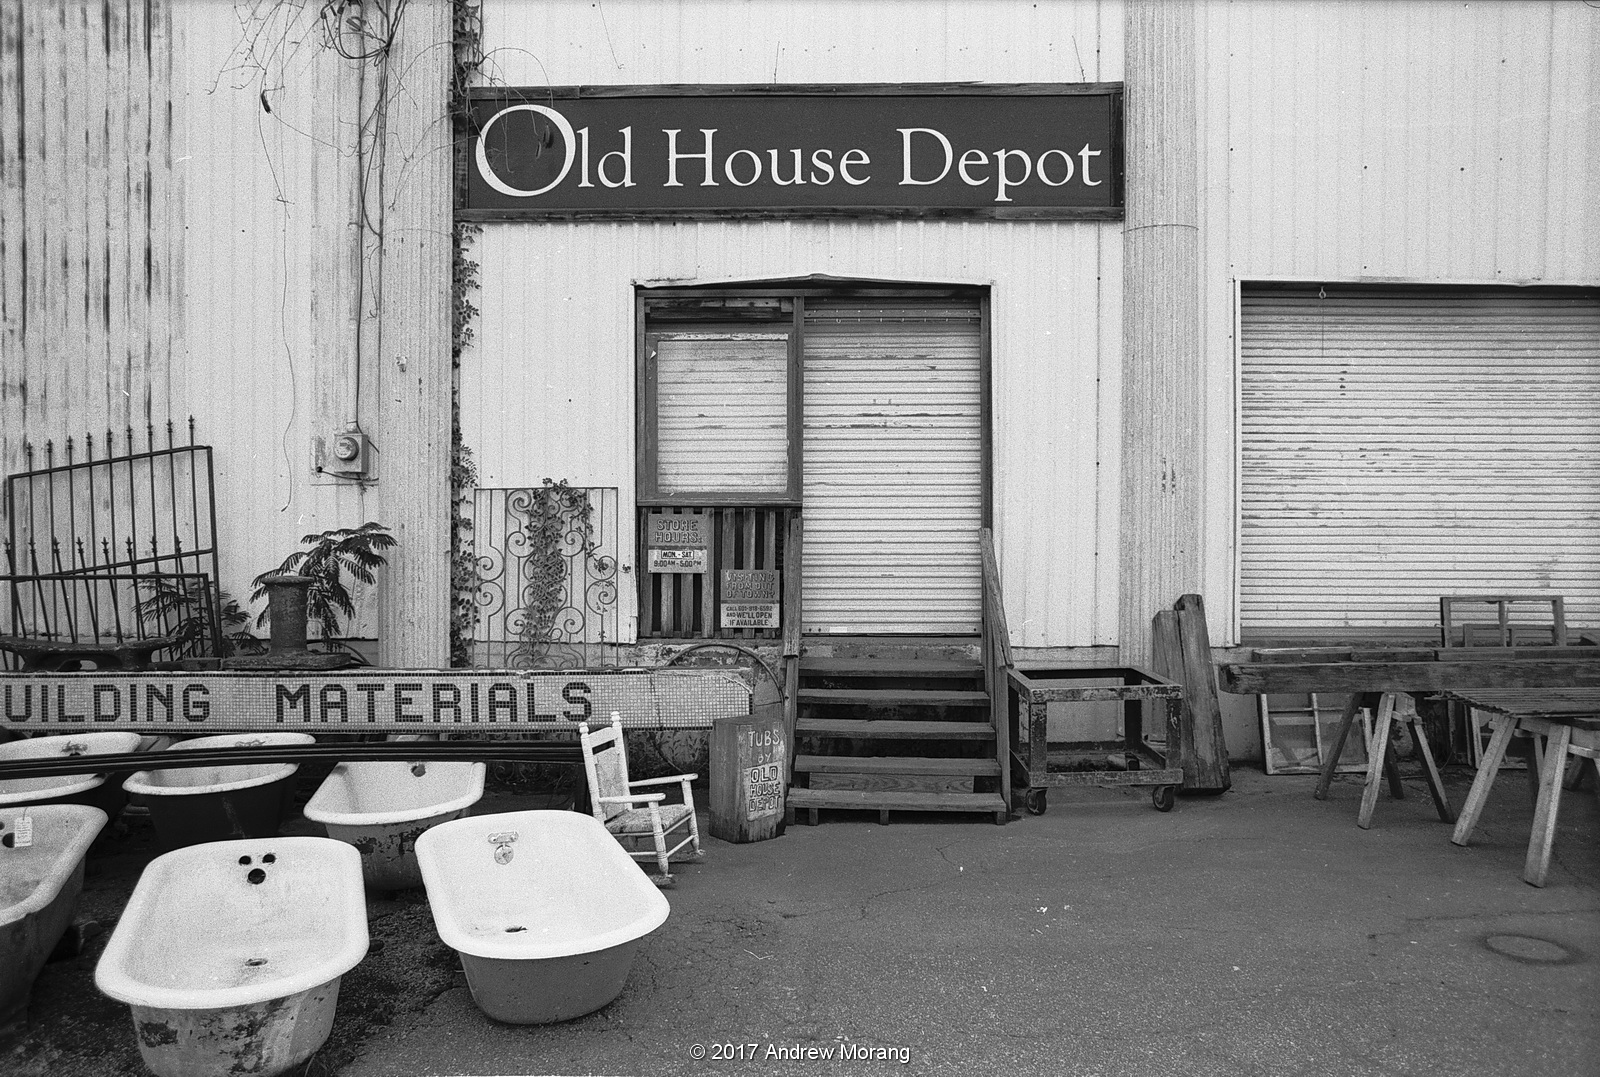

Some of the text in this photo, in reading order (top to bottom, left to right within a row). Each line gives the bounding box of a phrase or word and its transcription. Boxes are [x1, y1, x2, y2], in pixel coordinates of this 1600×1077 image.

[475, 103, 1104, 202] Old House Depot
[656, 519, 699, 531] STORE
[729, 619, 769, 627] IF AVAILABLE
[755, 611, 773, 619] OPEN
[276, 681, 593, 724] MATERIALS
[748, 729, 780, 747] TUBS
[750, 765, 778, 784] OLD
[750, 781, 781, 797] HOUSE
[749, 795, 781, 812] DEPOT
